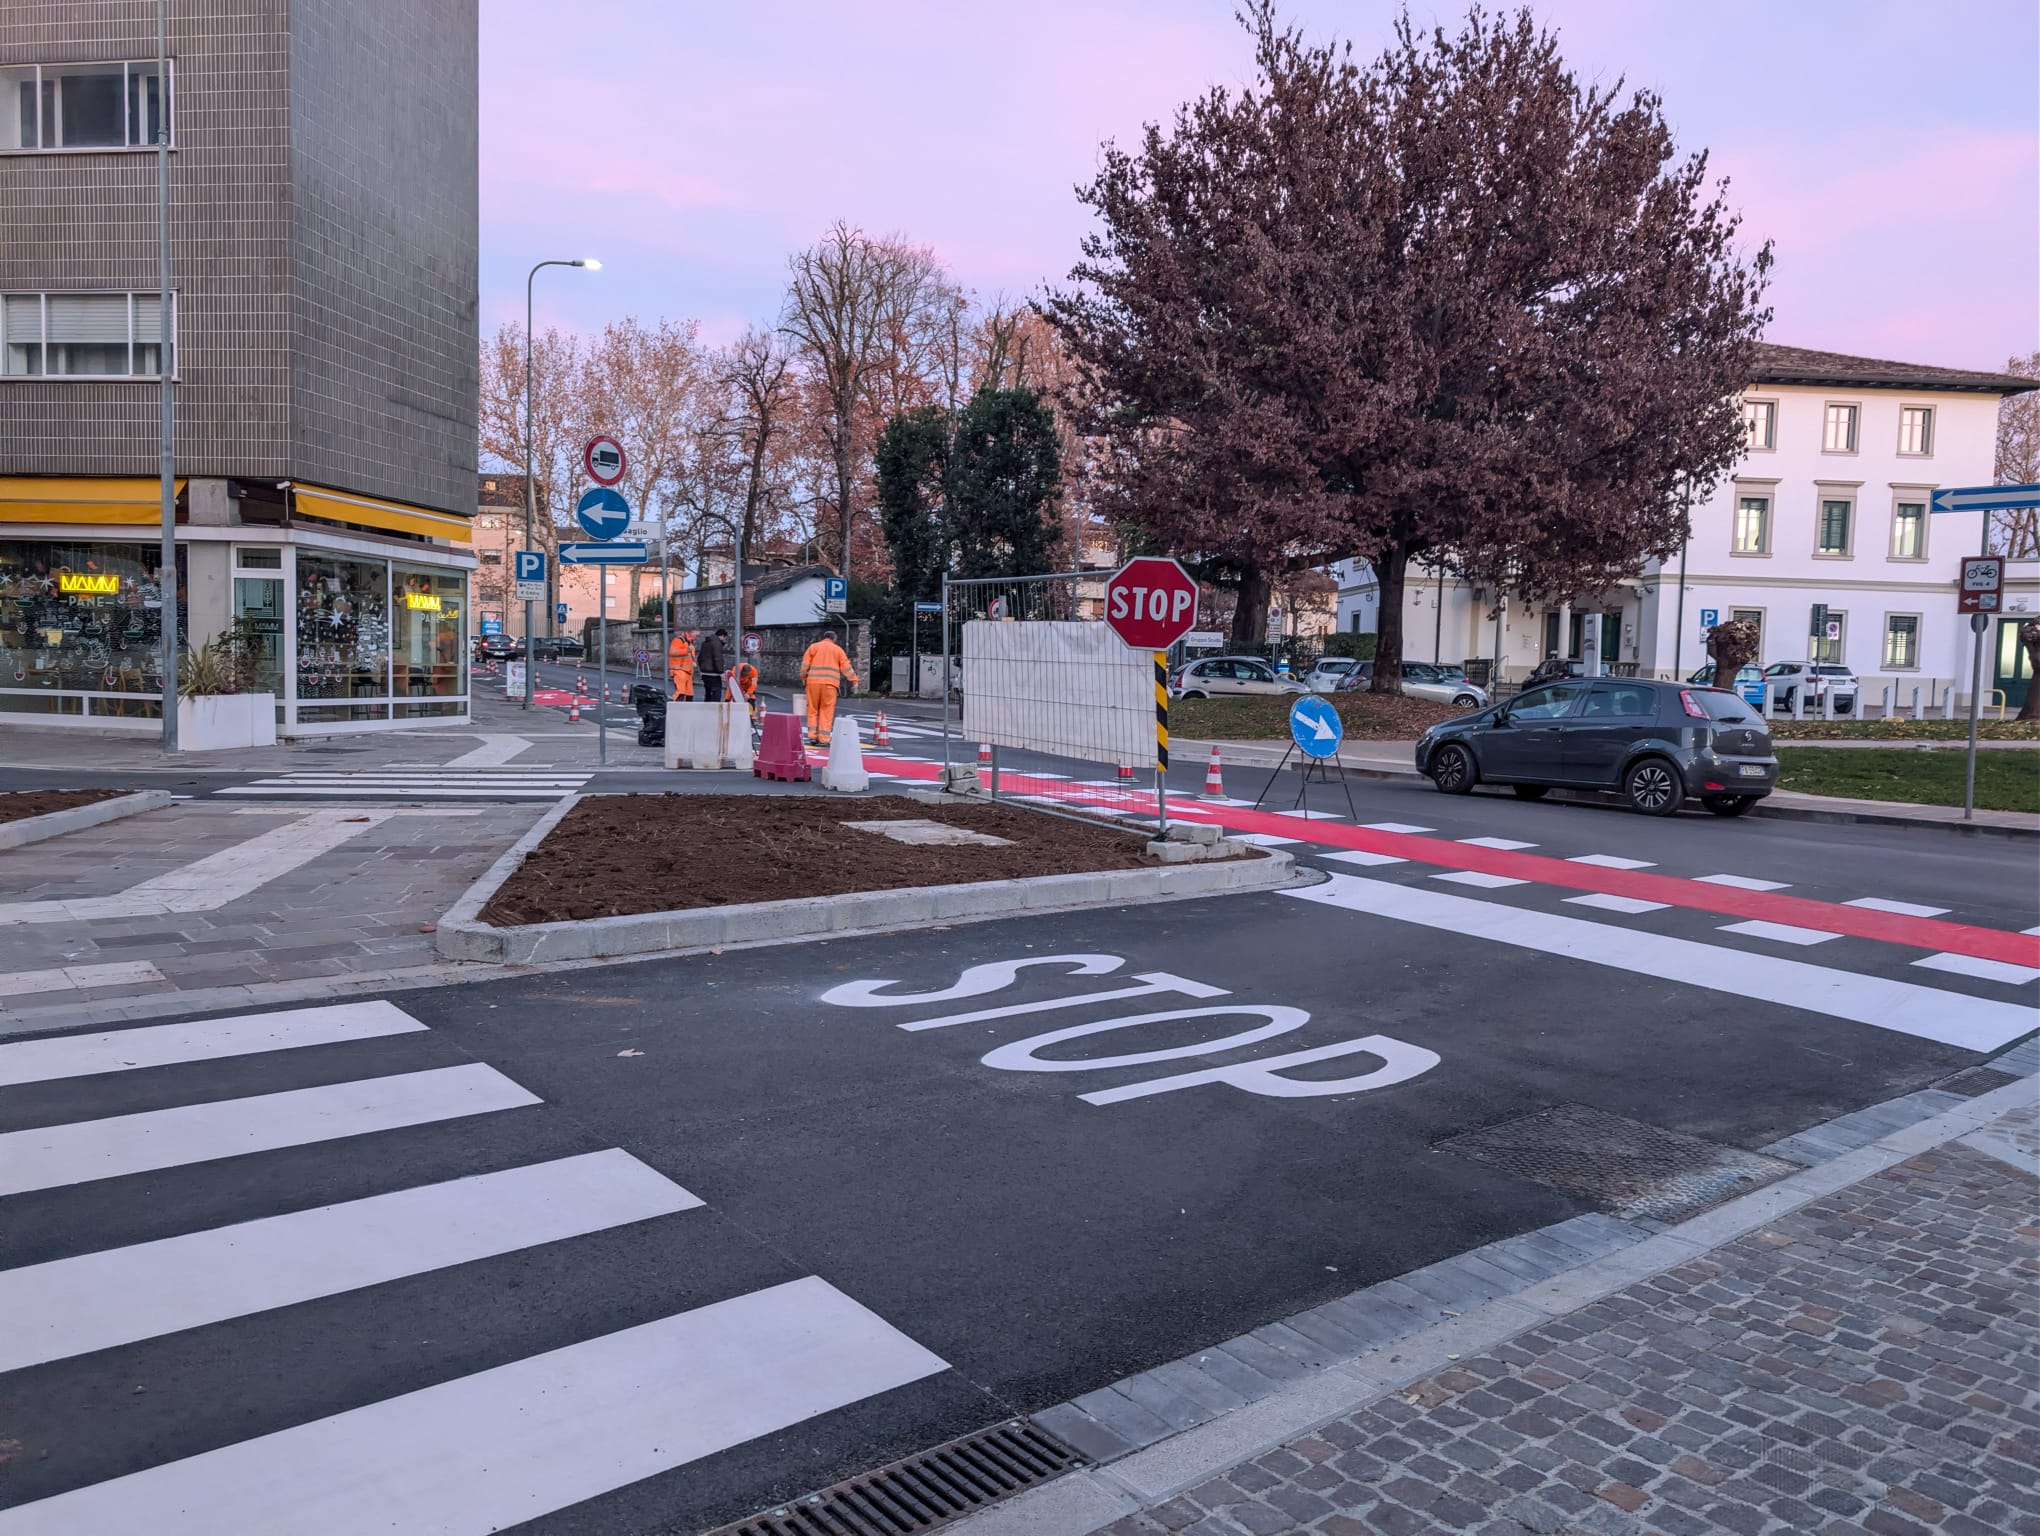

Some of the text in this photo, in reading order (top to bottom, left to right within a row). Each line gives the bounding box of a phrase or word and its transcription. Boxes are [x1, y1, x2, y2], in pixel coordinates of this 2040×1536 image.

[521, 554, 539, 578] P
[61, 575, 117, 592] MAMM
[831, 580, 843, 597] P
[69, 595, 105, 608] PANE
[408, 594, 440, 610] MAMM
[1111, 586, 1192, 623] STOP
[1704, 610, 1715, 625] P
[820, 954, 1441, 1106] STOP
